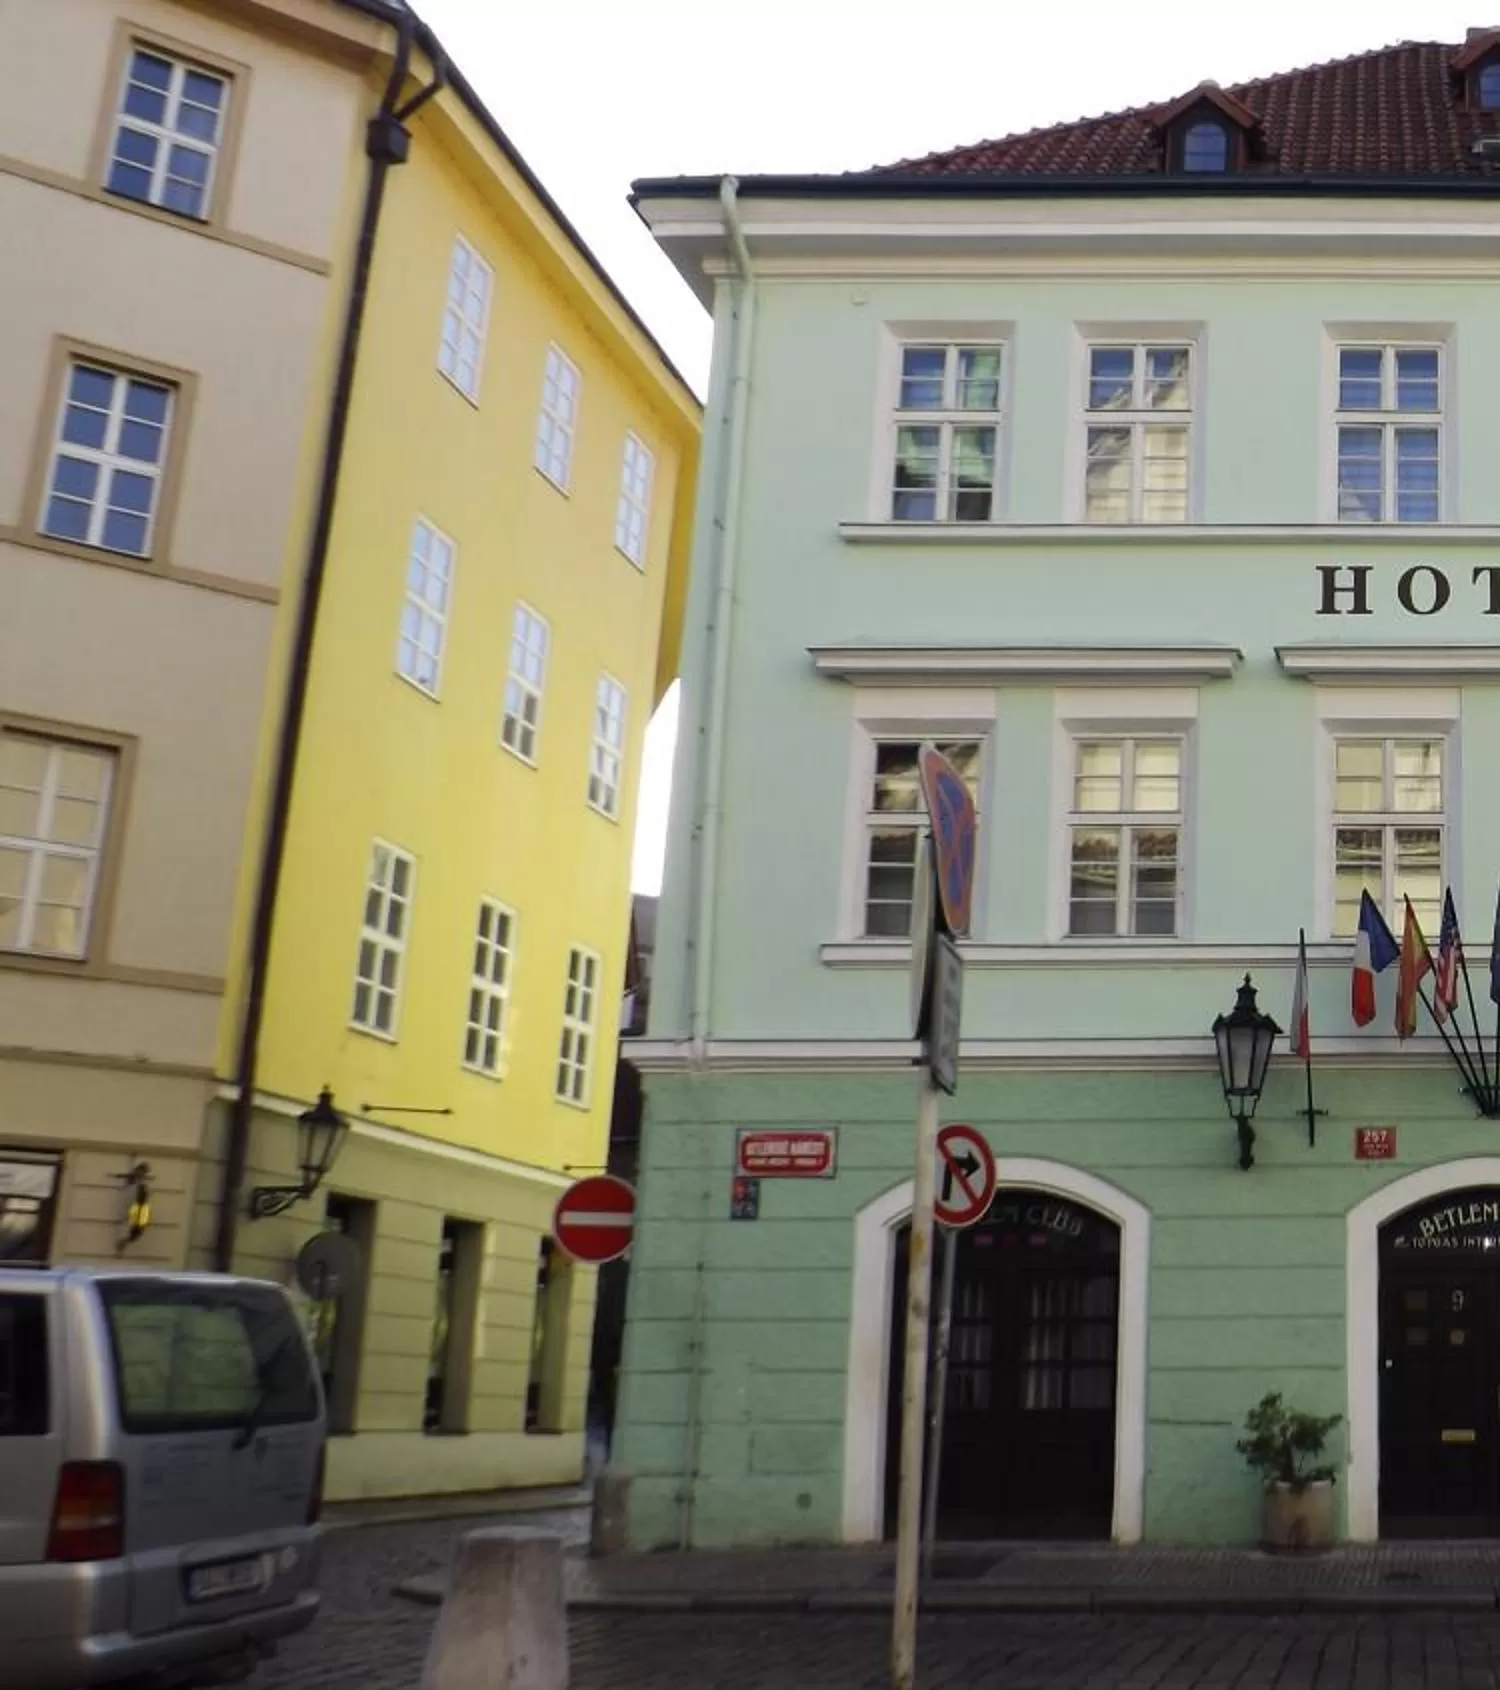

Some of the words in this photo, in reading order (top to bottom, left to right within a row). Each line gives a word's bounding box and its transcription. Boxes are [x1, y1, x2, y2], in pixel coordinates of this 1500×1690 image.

[1363, 1129, 1387, 1143] 257
[1419, 1203, 1499, 1238] BETLEM
[1451, 1288, 1466, 1313] 9
